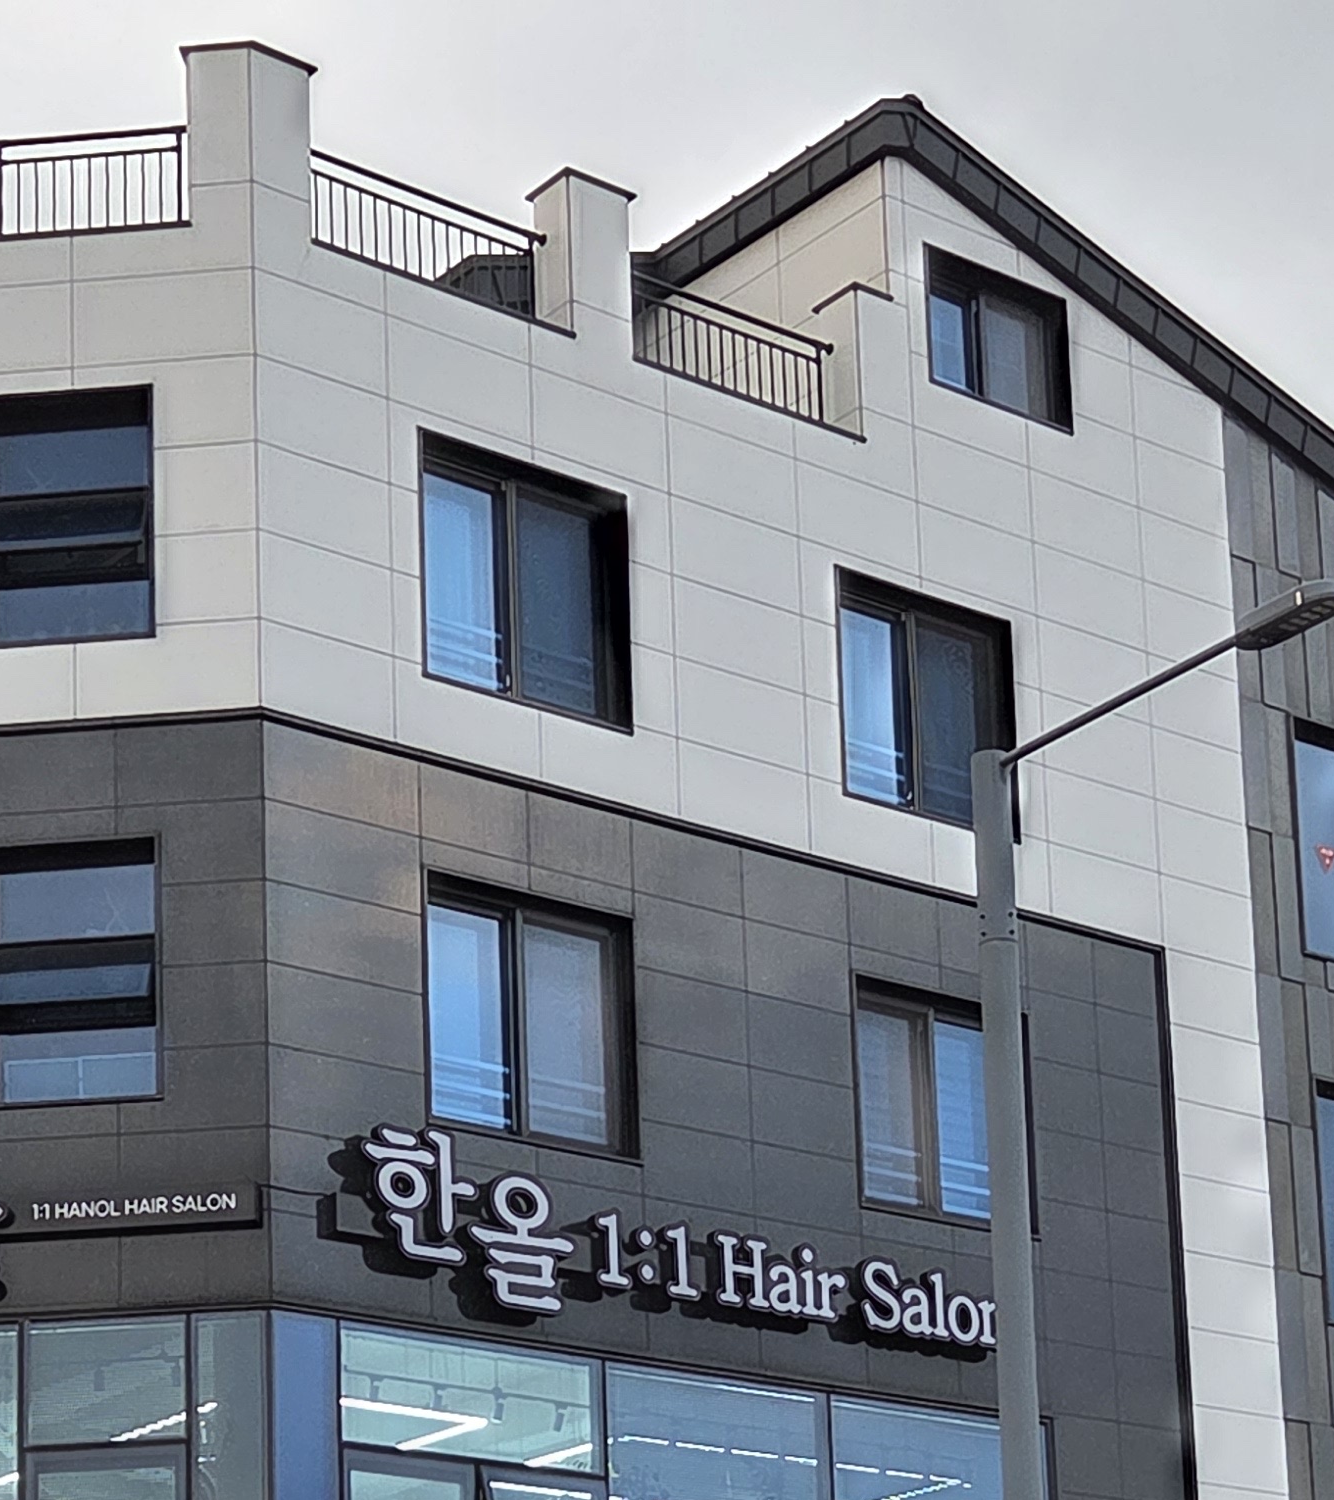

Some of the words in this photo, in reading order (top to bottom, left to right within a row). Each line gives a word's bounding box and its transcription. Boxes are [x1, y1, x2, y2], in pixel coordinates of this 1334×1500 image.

[32, 1203, 51, 1220] 1:1
[55, 1200, 121, 1220] HANOL
[124, 1196, 169, 1215] HAIR
[172, 1193, 237, 1213] SALON
[365, 1126, 575, 1311] 한올
[597, 1212, 698, 1298] 1:1
[718, 1233, 845, 1320] Hair
